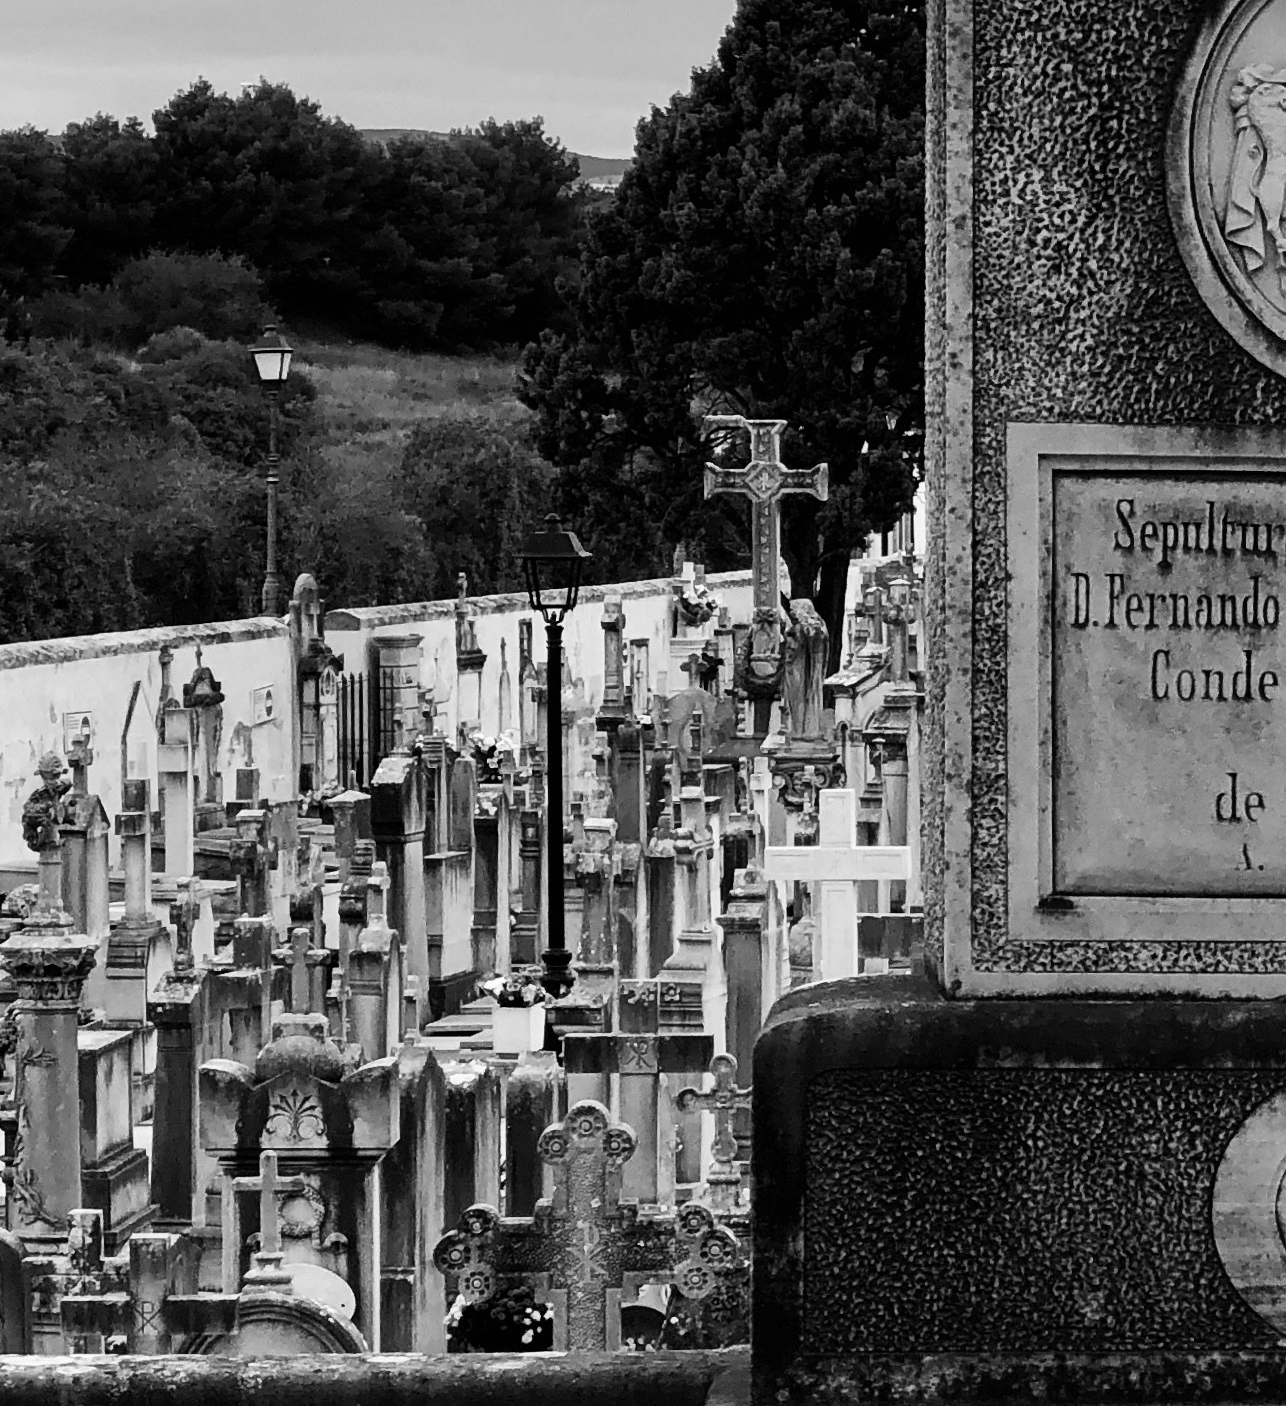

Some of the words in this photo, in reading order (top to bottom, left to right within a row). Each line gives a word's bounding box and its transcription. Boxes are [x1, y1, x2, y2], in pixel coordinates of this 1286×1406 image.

[1104, 573, 1281, 631] Fernando
[1151, 649, 1280, 703] Conde
[1215, 772, 1266, 824] de
